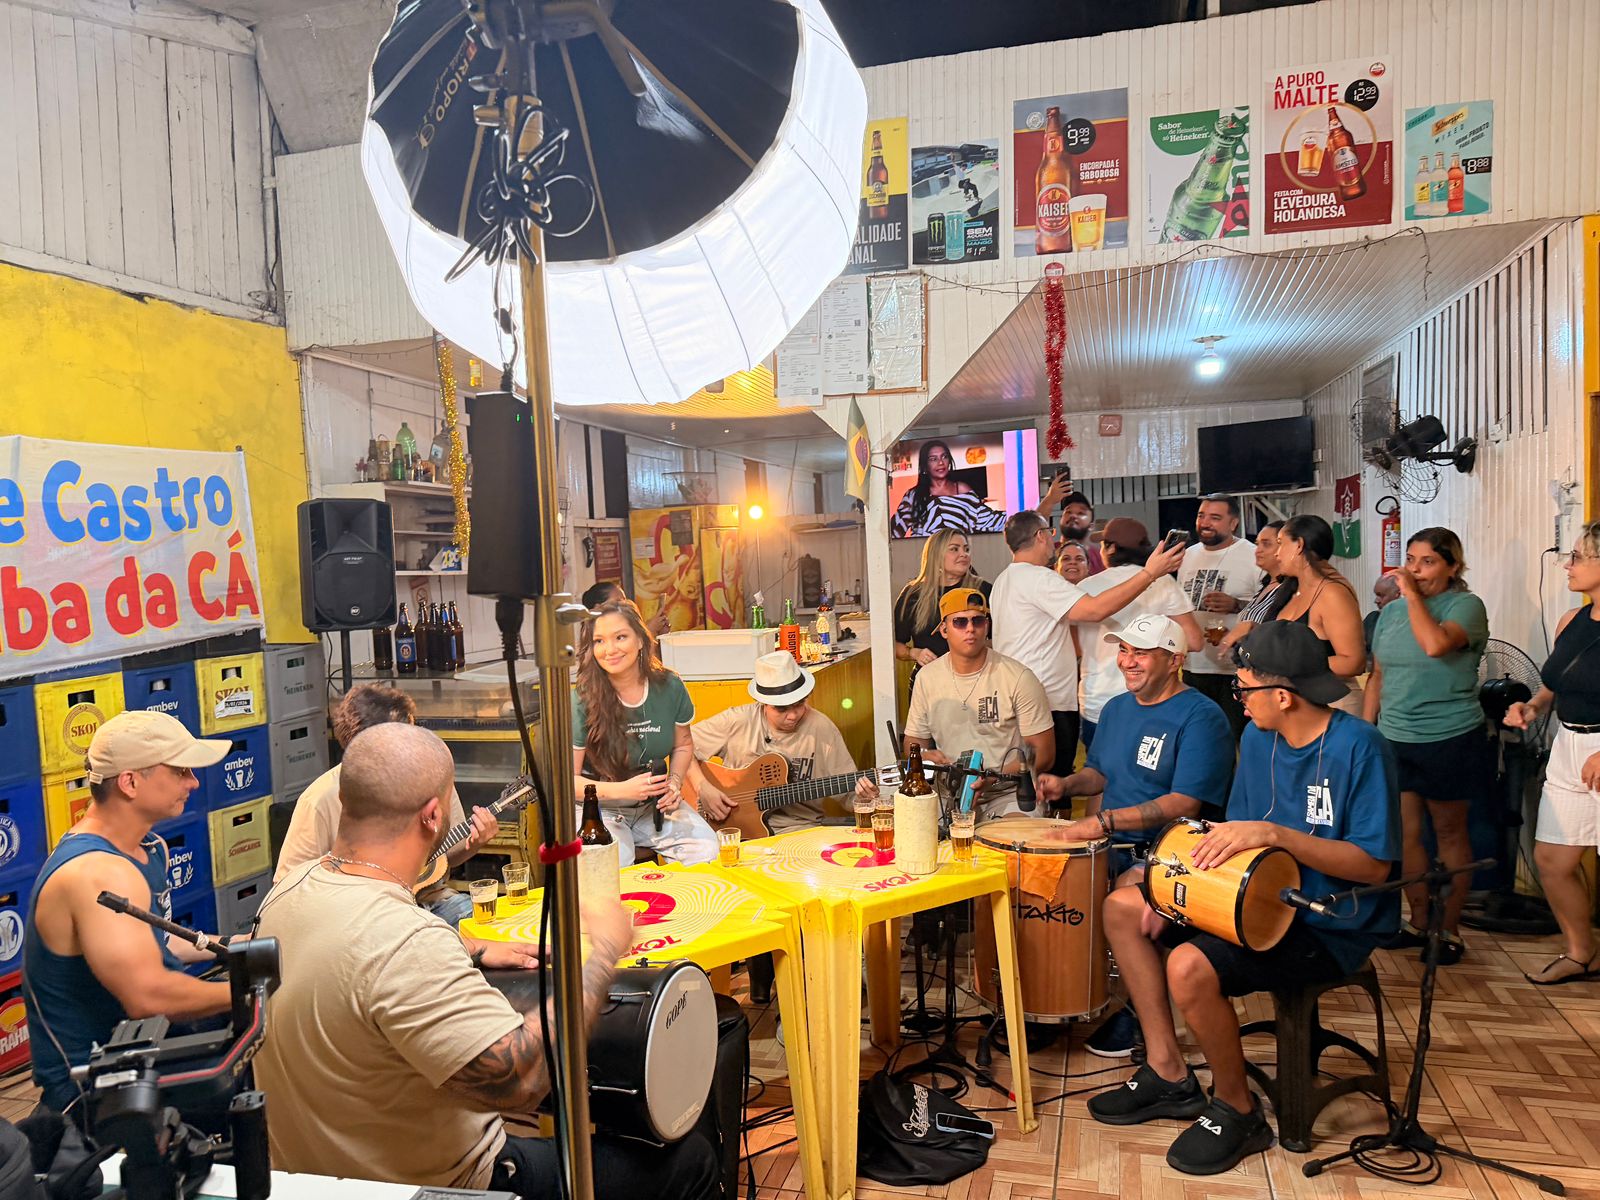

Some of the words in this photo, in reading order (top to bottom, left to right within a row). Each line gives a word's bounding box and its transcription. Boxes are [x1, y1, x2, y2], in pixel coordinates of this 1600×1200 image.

[1274, 76, 1284, 90] A
[1287, 70, 1325, 88] PURO
[1274, 84, 1340, 110] MALTE
[1157, 122, 1182, 131] Sabor
[1079, 160, 1115, 171] ENCORPADA
[1115, 159, 1120, 167] E
[1079, 168, 1120, 180] SABOROSA
[1273, 190, 1289, 198] FEITA
[1289, 188, 1303, 196] COM
[1273, 192, 1337, 211] LEVEDURA
[1273, 204, 1347, 223] HOLANDESA
[853, 222, 902, 245] ALIDADE
[966, 226, 993, 236] SEM
[847, 245, 878, 265] ANAL
[0, 478, 25, 544] e
[42, 459, 234, 543] Castro
[0, 565, 91, 651] ba
[105, 555, 179, 635] da
[187, 528, 261, 621] CÁ
[224, 756, 254, 772] ambev
[169, 851, 193, 867] mbev
[863, 873, 920, 893] SKOL
[1011, 902, 1085, 926] TAKTO
[665, 990, 688, 1030] GOPE
[0, 1026, 30, 1053] RAHM
[1195, 1115, 1223, 1136] FILA
